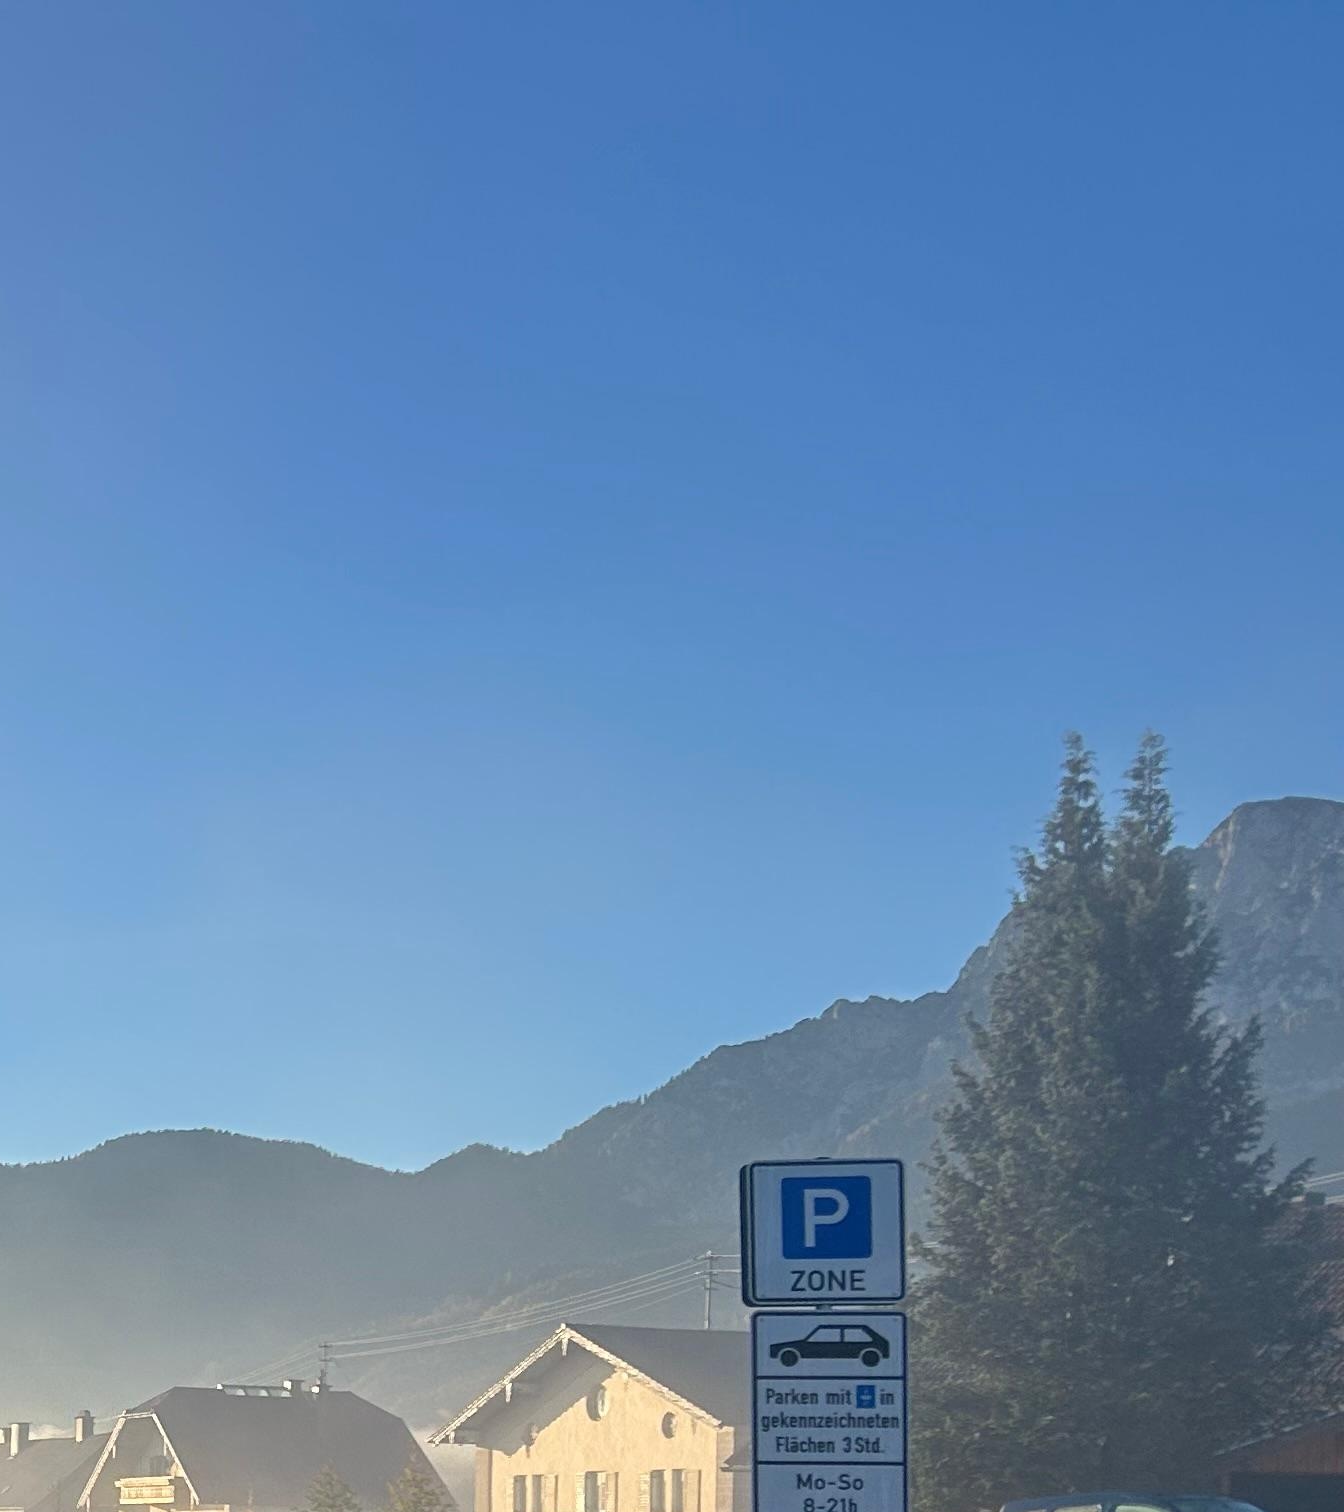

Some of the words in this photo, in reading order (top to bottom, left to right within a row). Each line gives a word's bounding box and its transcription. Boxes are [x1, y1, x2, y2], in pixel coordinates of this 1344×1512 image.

[803, 1188, 850, 1248] P
[790, 1270, 866, 1292] ZONE
[765, 1388, 819, 1405] Parken
[825, 1389, 852, 1405] mit
[879, 1389, 895, 1405] in
[761, 1411, 900, 1431] gekennzeichneten
[775, 1436, 835, 1454] Flächen
[796, 1473, 864, 1491] Mo-So
